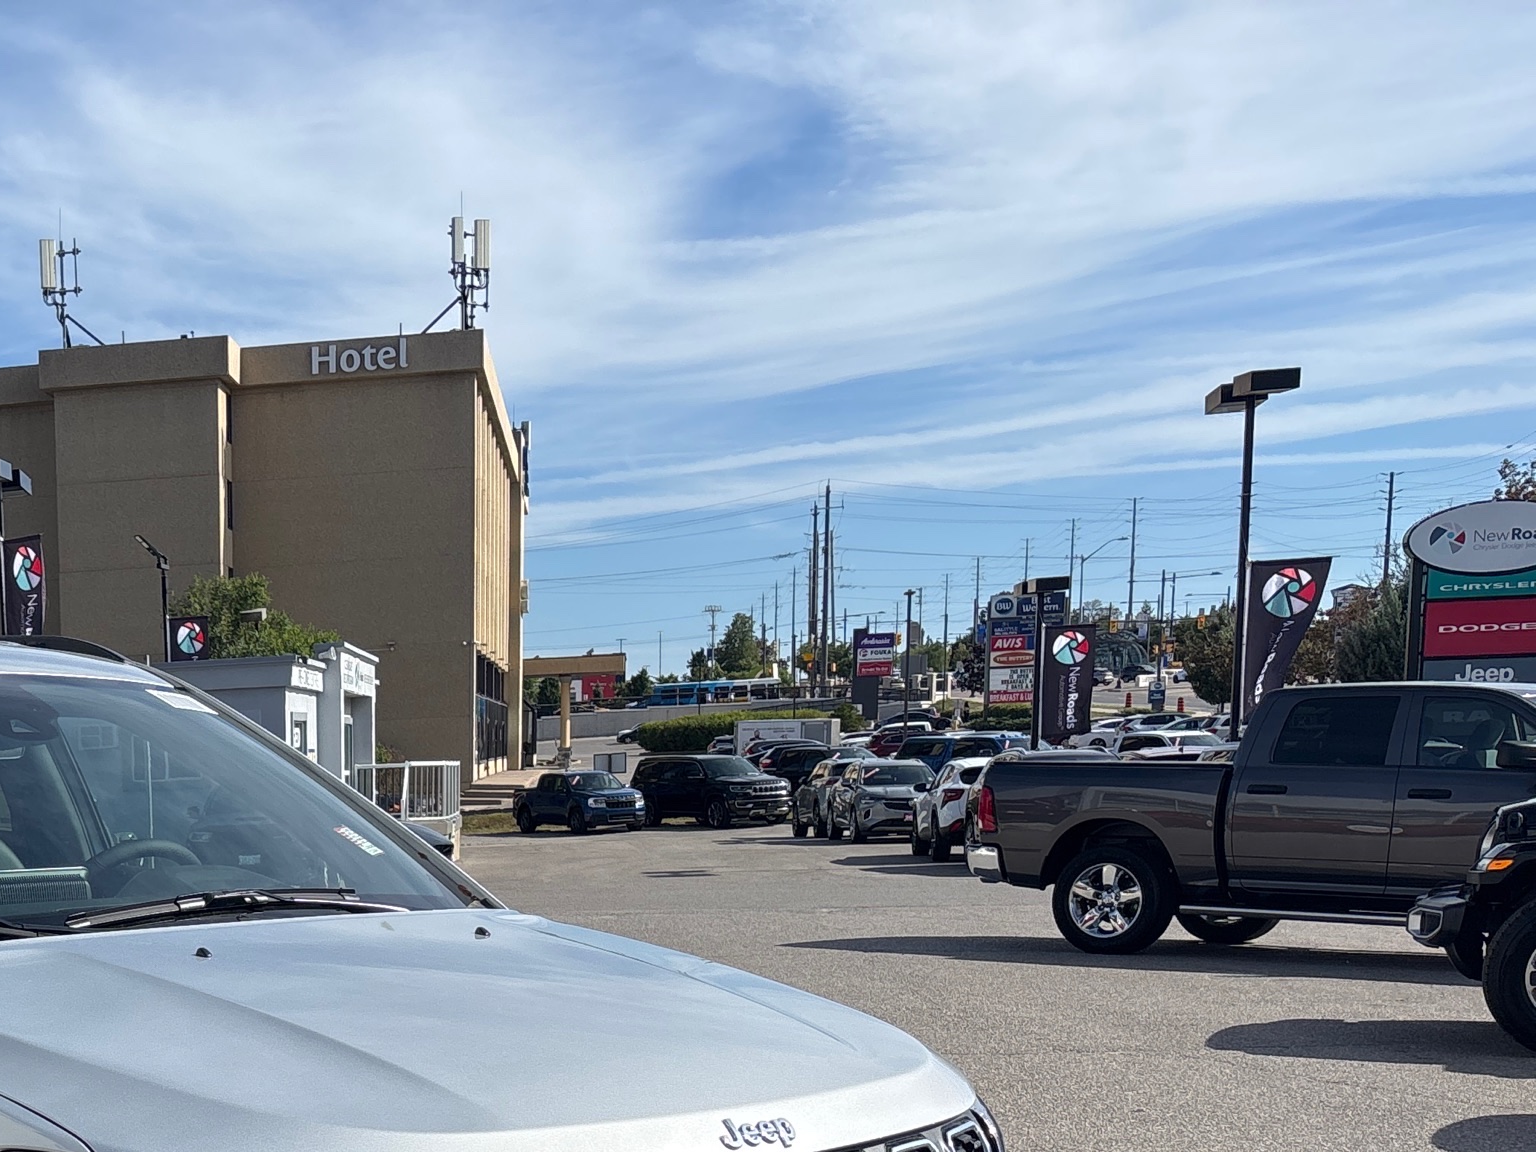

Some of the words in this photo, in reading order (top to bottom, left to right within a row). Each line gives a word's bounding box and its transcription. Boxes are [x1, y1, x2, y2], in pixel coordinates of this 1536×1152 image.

[311, 337, 409, 375] Hotel
[1438, 622, 1536, 633] DODGE
[993, 638, 1023, 649] AVIS
[1455, 663, 1515, 682] Jeep
[990, 693, 1020, 702] BREAKFAST
[719, 1117, 796, 1150] Jeep
